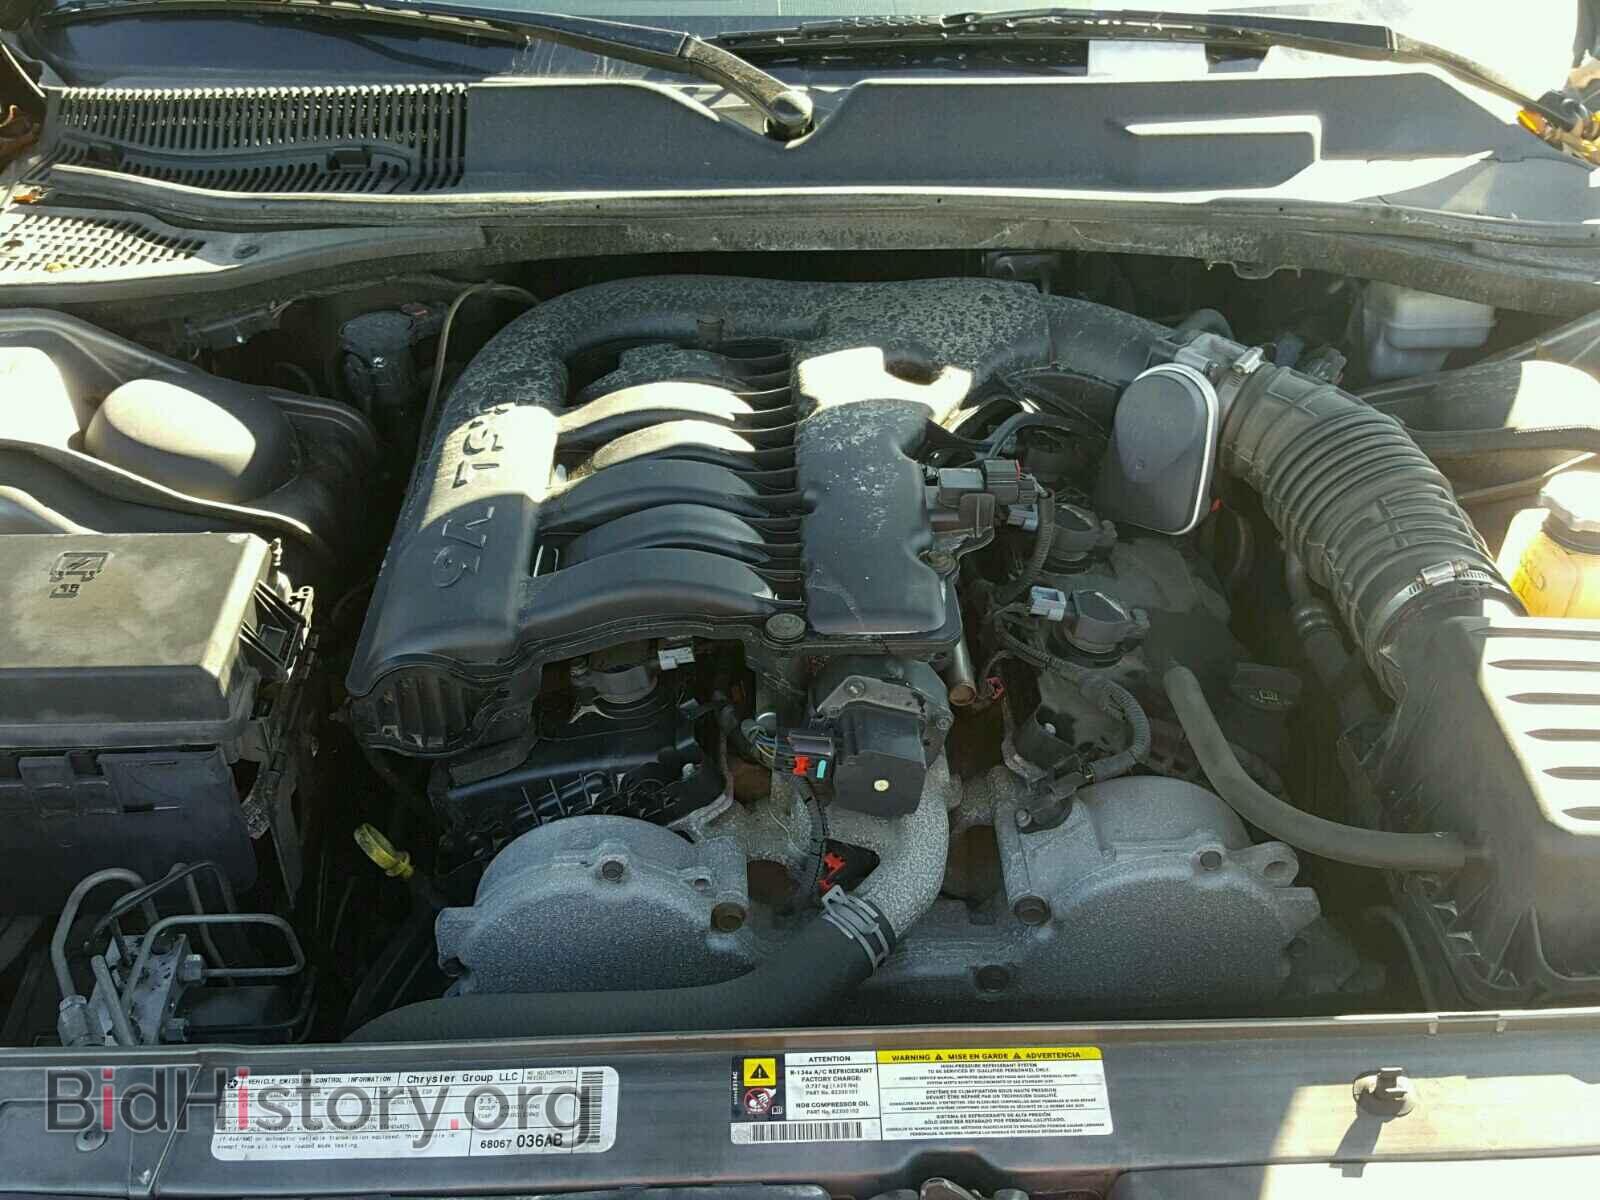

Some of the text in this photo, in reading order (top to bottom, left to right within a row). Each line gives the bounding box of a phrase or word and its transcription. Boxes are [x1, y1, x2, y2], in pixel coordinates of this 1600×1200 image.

[1026, 1051, 1081, 1059] ADVERTENCIA
[348, 1075, 392, 1083] INFORMATION
[407, 1072, 519, 1085] Chrysler Group LLC
[480, 1132, 563, 1149] 68067 036AB
